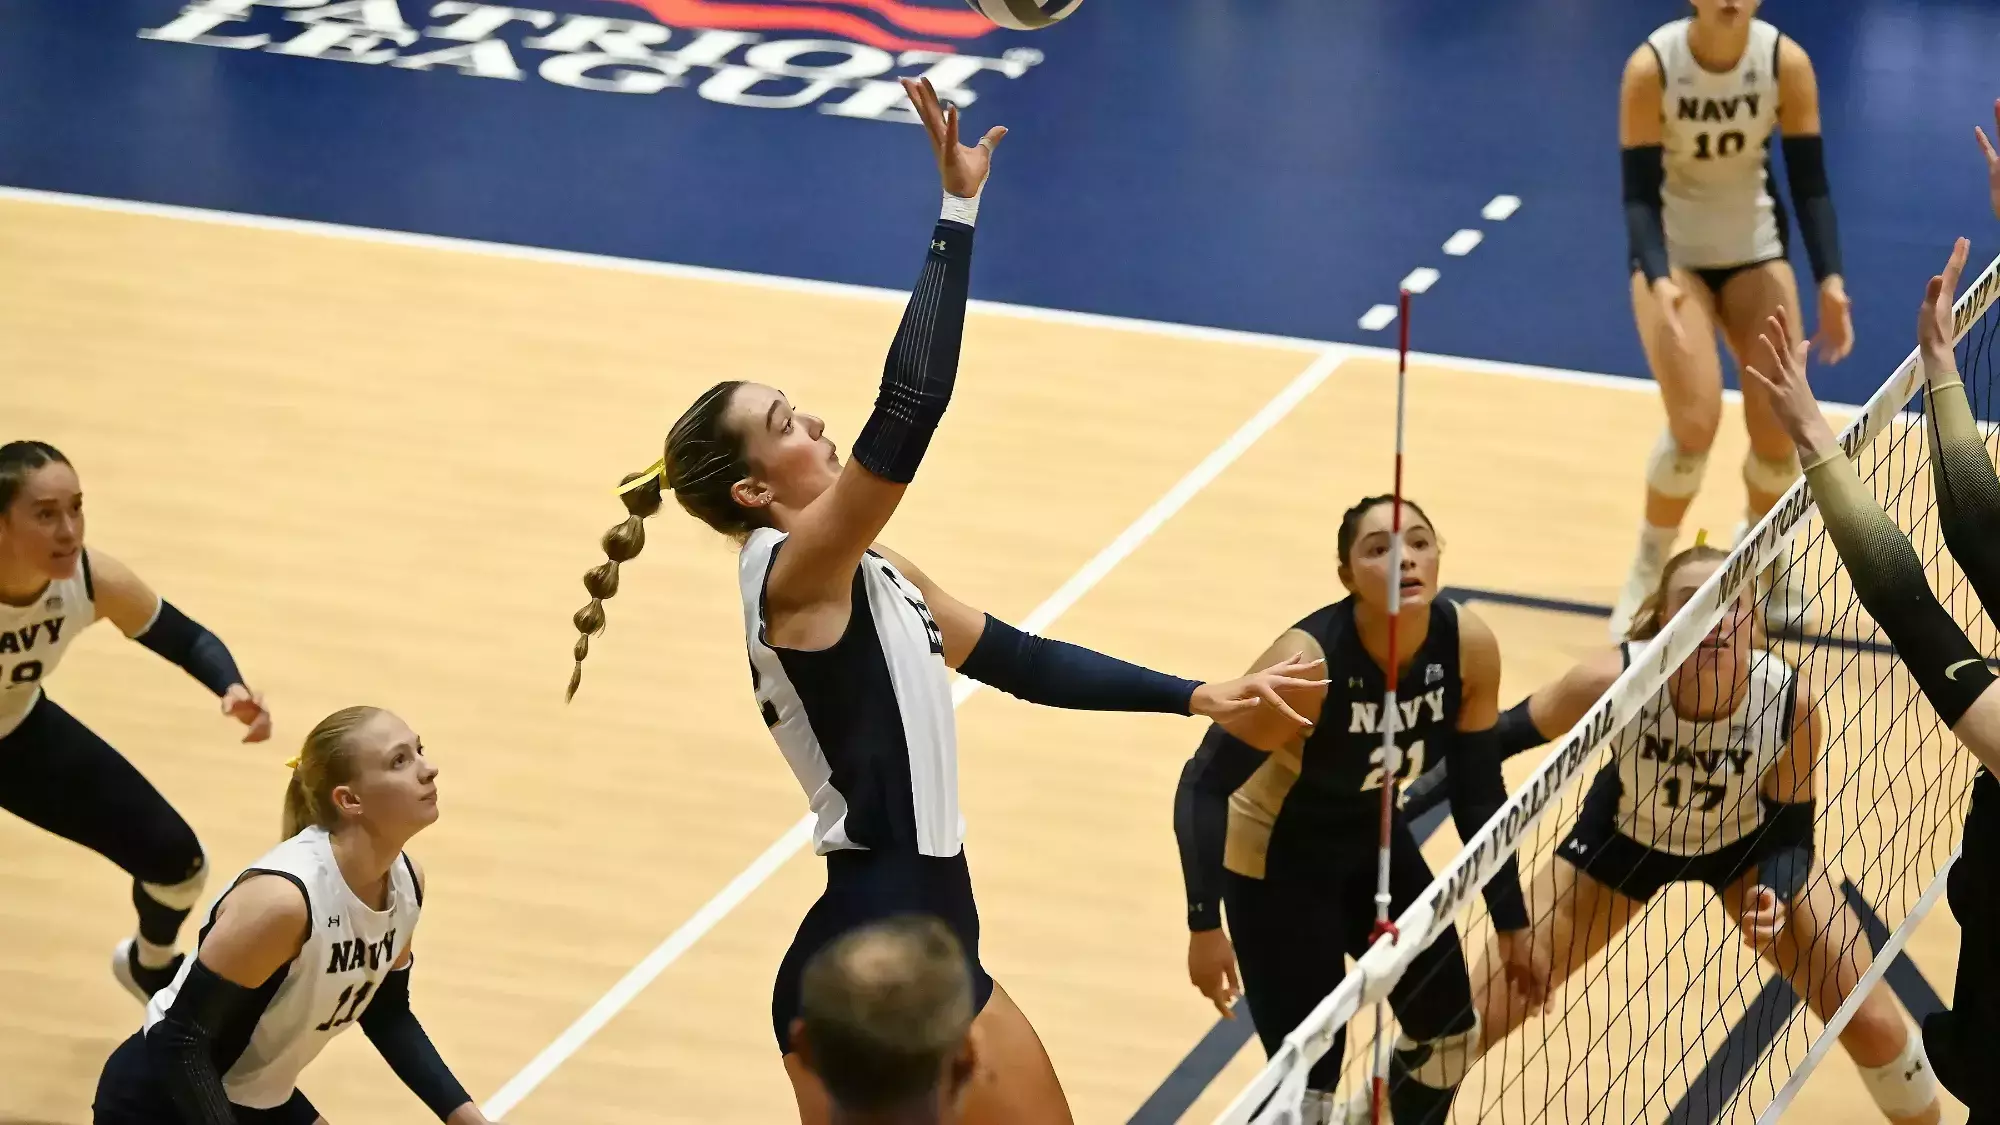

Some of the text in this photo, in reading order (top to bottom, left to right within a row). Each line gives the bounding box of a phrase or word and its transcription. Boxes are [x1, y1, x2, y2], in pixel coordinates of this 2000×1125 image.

[136, 5, 977, 126] LEAGUE
[1676, 92, 1760, 122] NAVY
[1693, 131, 1746, 160] 10
[1714, 526, 1767, 611] NAVY
[0, 615, 65, 653] AVY
[1348, 686, 1445, 734] NAVY
[1360, 739, 1425, 792] 21
[1640, 733, 1753, 776] NAVY
[1492, 698, 1615, 862] VOLLEYBALL
[1661, 777, 1727, 811] 17
[326, 927, 396, 974] NAVY
[314, 980, 374, 1031] 11
